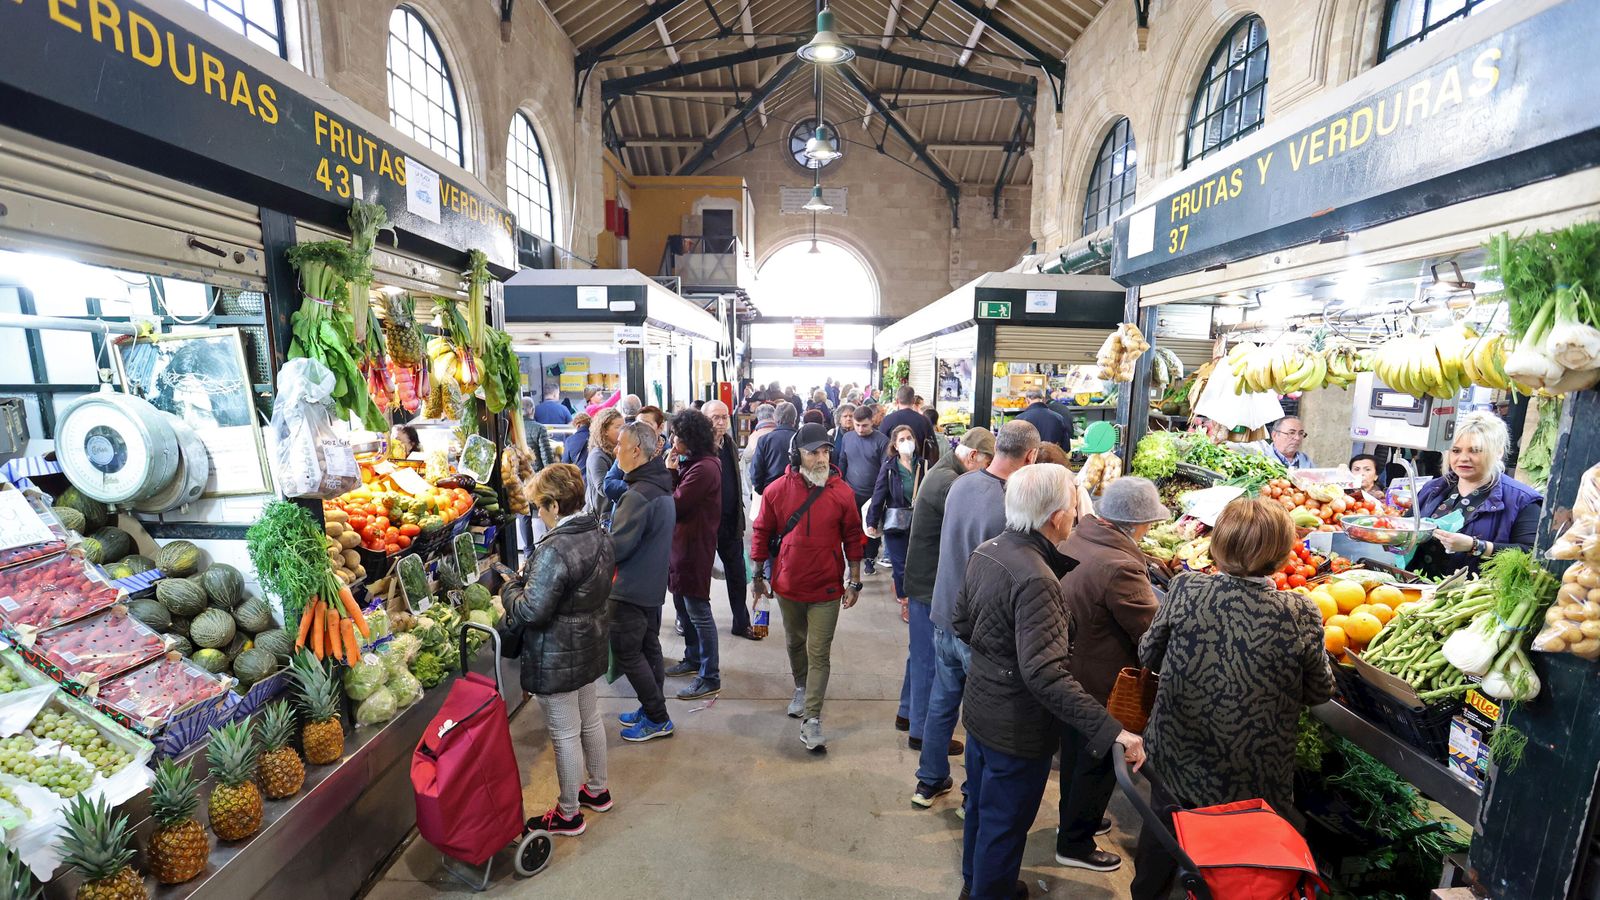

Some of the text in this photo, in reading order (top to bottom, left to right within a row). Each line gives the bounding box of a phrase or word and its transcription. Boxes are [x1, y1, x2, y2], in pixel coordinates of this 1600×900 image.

[14, 0, 279, 125] ERDURAS
[314, 111, 514, 237] FRUTAS VERDURAS
[316, 157, 350, 198] 43
[1171, 48, 1502, 221] FRUTAS Y VERDURAS
[1168, 224, 1188, 255] 37
